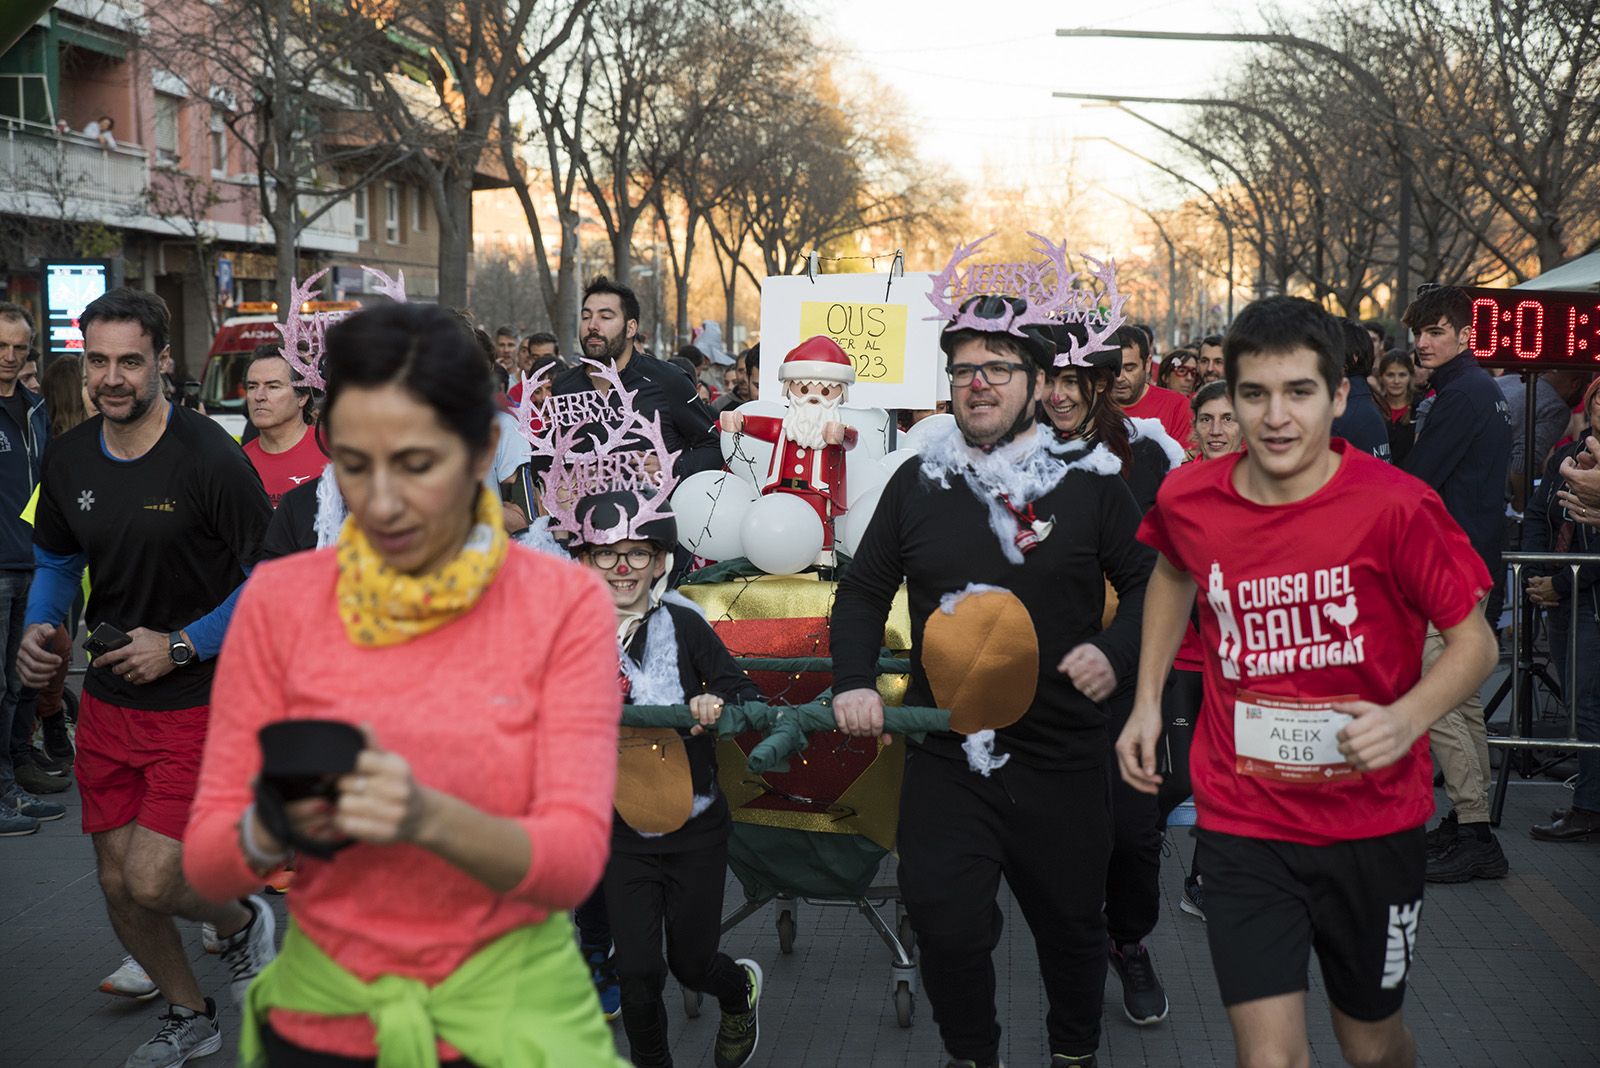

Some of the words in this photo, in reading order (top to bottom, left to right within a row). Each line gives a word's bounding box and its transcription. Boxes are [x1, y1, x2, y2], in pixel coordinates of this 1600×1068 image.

[827, 304, 886, 337] OUS
[1470, 298, 1600, 360] 0:01:
[865, 340, 880, 351] AL
[529, 406, 626, 432] CHRISTMAS
[530, 389, 617, 421] MERRY
[560, 449, 656, 482] MERRY
[1238, 572, 1308, 610] CURSA
[1314, 564, 1355, 600] DEL
[1243, 604, 1331, 651] GALL
[1244, 648, 1297, 677] SANT
[1300, 635, 1365, 670] CUGAT
[1270, 727, 1321, 742] ALEIX
[1278, 744, 1314, 761] 616
